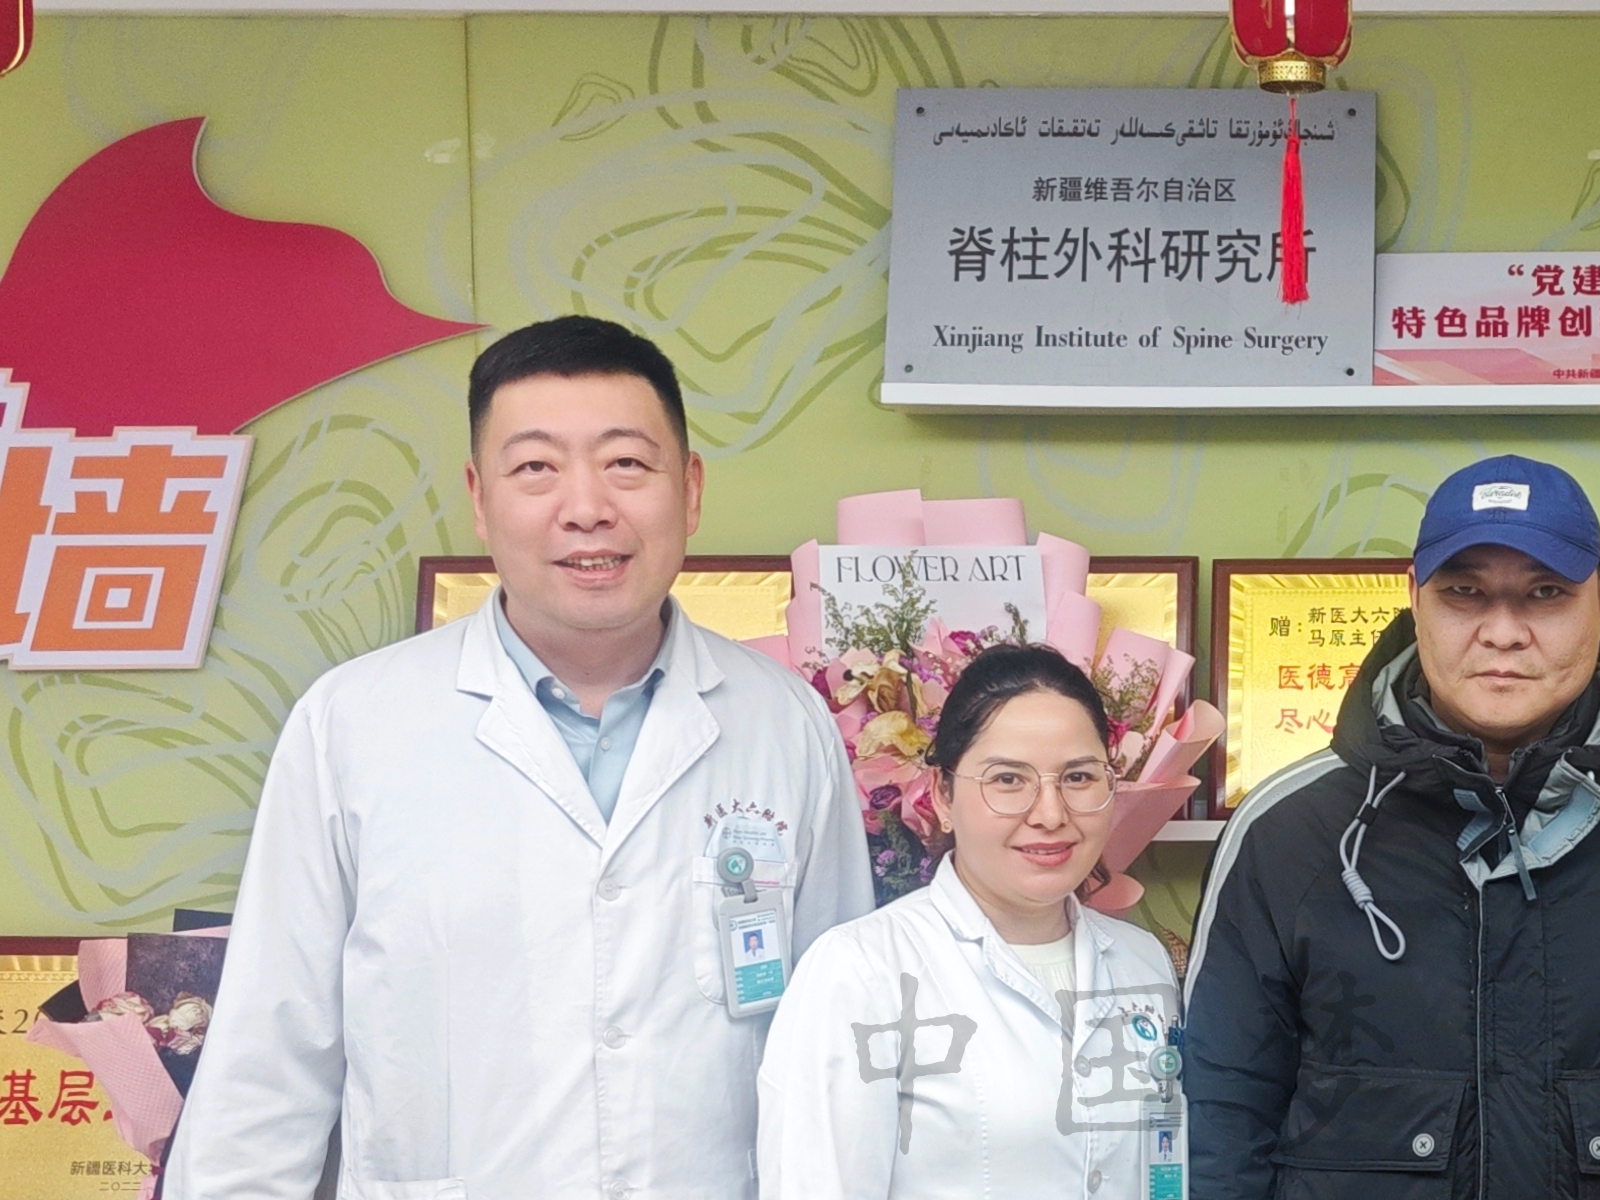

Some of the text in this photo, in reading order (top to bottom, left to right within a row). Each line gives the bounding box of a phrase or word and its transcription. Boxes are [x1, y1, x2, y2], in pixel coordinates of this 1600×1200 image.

[1032, 177, 1237, 203] 新疆维吾尔自治区
[932, 326, 1329, 356] Xinjiang Institute of Spine Surgery
[836, 555, 1026, 583] FLOWER ART
[0, 1069, 113, 1126] 基层
[70, 1161, 152, 1176] 新疆医科大
